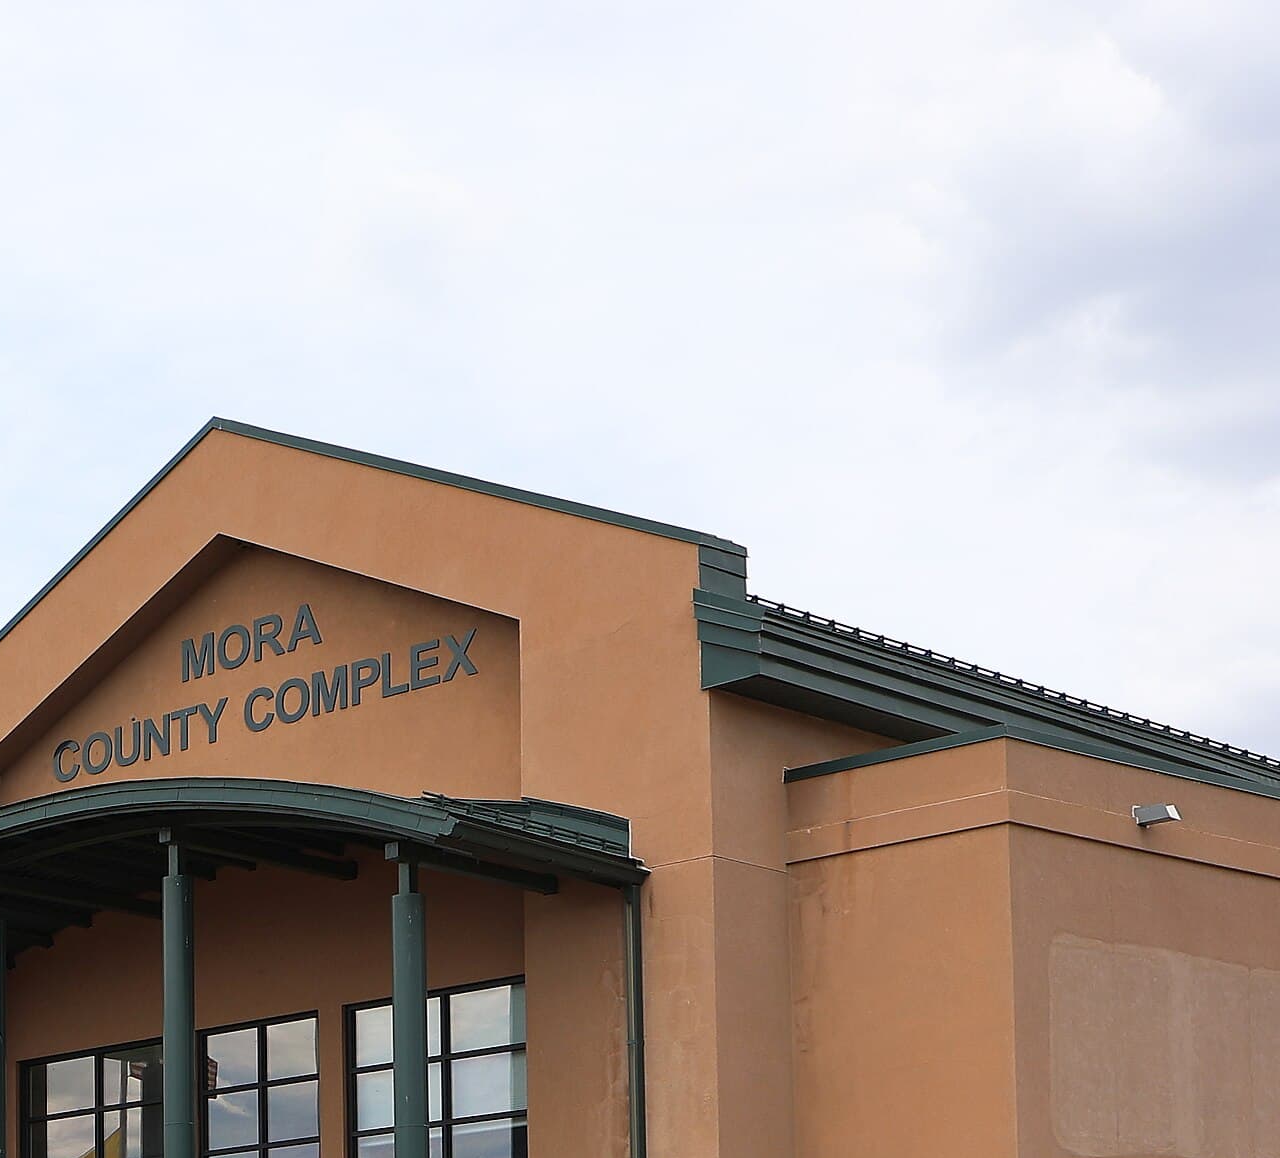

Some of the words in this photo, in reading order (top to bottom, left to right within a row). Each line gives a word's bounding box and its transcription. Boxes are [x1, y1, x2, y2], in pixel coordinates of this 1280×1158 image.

[181, 603, 323, 682] MORA
[52, 696, 229, 783] COUNTY
[243, 628, 479, 733] COMPLEX
